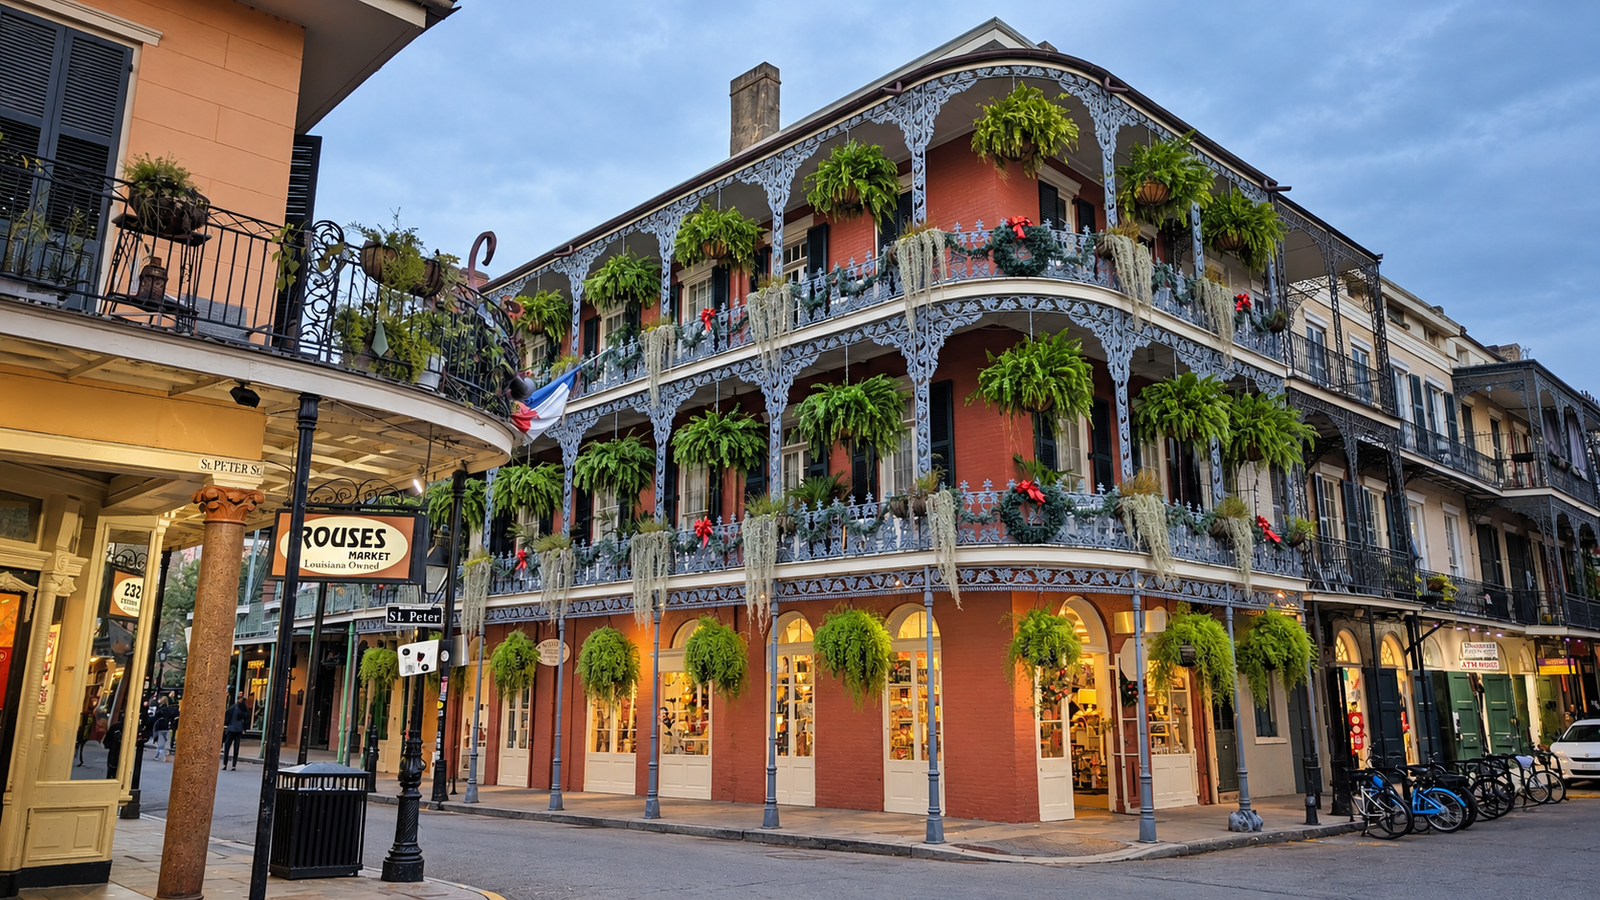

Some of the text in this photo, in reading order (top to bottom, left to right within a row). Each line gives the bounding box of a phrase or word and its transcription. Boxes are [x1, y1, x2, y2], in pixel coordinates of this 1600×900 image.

[214, 460, 248, 474] PETER
[302, 526, 387, 549] ROUSES
[348, 551, 391, 561] MARKET
[304, 559, 379, 570] Louisiana Owned
[409, 611, 440, 622] Peter
